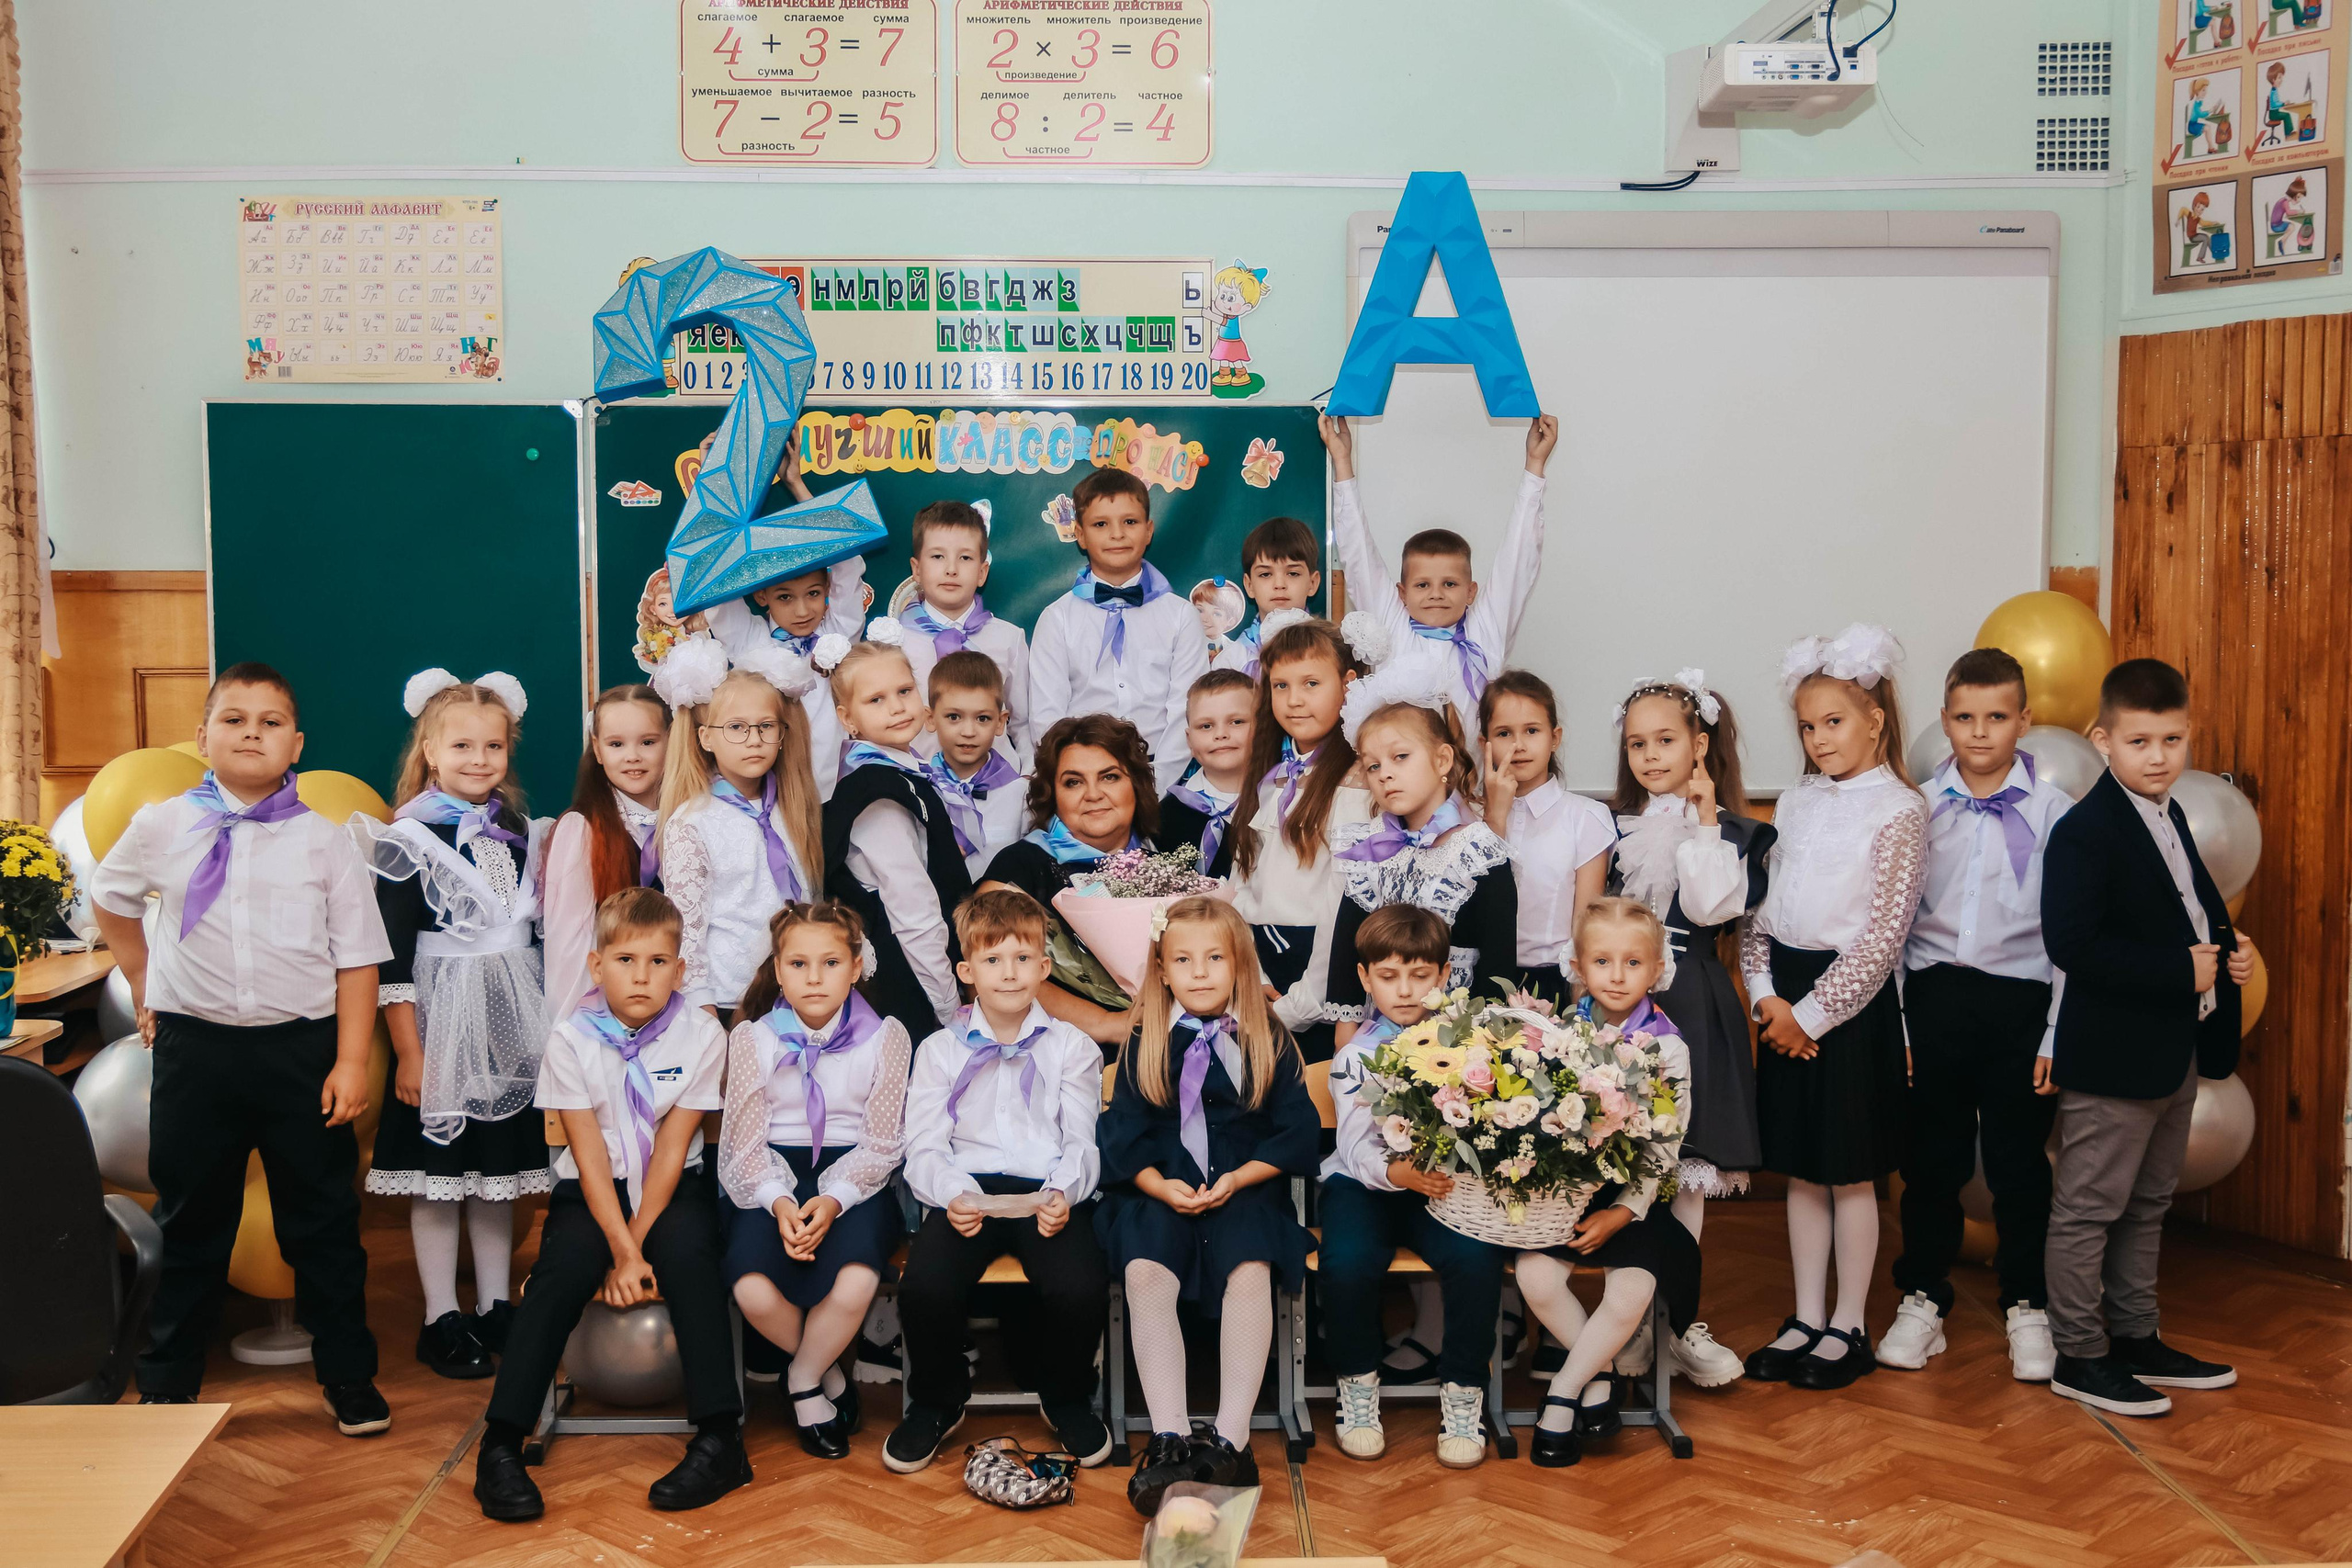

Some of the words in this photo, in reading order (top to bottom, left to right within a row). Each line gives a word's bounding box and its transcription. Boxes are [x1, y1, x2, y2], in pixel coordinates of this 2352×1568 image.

[983, 1, 1110, 10] АРИФМЕТИЧЕСКИЕ
[1114, 0, 1183, 11] ДЕЙСТВИЯ
[873, 16, 910, 25] сумма
[1046, 17, 1111, 25] множитель
[1120, 17, 1203, 27] произведение
[713, 27, 743, 64] 4
[799, 28, 829, 67] 3
[878, 28, 905, 66] 7
[987, 28, 1019, 68] 2
[1071, 28, 1101, 69] 3
[1150, 28, 1181, 69] 6
[758, 69, 794, 77] сумма
[1004, 72, 1078, 81] произведение
[692, 88, 773, 97] уменьшаемое
[862, 90, 916, 99] разность
[980, 92, 1030, 100] делимое
[1063, 92, 1116, 100] делитель
[713, 100, 740, 138] 7
[800, 101, 832, 140] 2
[874, 102, 905, 140] 5
[990, 102, 1020, 141] 8
[1074, 102, 1106, 141] 2
[1146, 104, 1175, 141] 4
[741, 142, 795, 152] разность
[295, 200, 366, 218] РУССКИЙ
[370, 202, 442, 215] АЛФАВИТ
[684, 361, 696, 389] 0
[705, 361, 714, 389] 1
[721, 361, 733, 389] 2
[823, 362, 834, 389] 7
[842, 361, 854, 389] 8
[863, 361, 875, 389] 9
[883, 361, 907, 389] 10
[915, 361, 933, 389] 11
[941, 361, 963, 389] 12
[970, 361, 992, 389] 13
[1001, 361, 1023, 389] 14
[1032, 361, 1054, 390] 15
[1062, 362, 1084, 390] 16
[1092, 362, 1113, 389] 17
[1121, 362, 1143, 390] 18
[1151, 362, 1173, 390] 19
[1182, 362, 1207, 390] 20
[938, 421, 1072, 468] КЛАСС
[1096, 428, 1143, 467] ПРО
